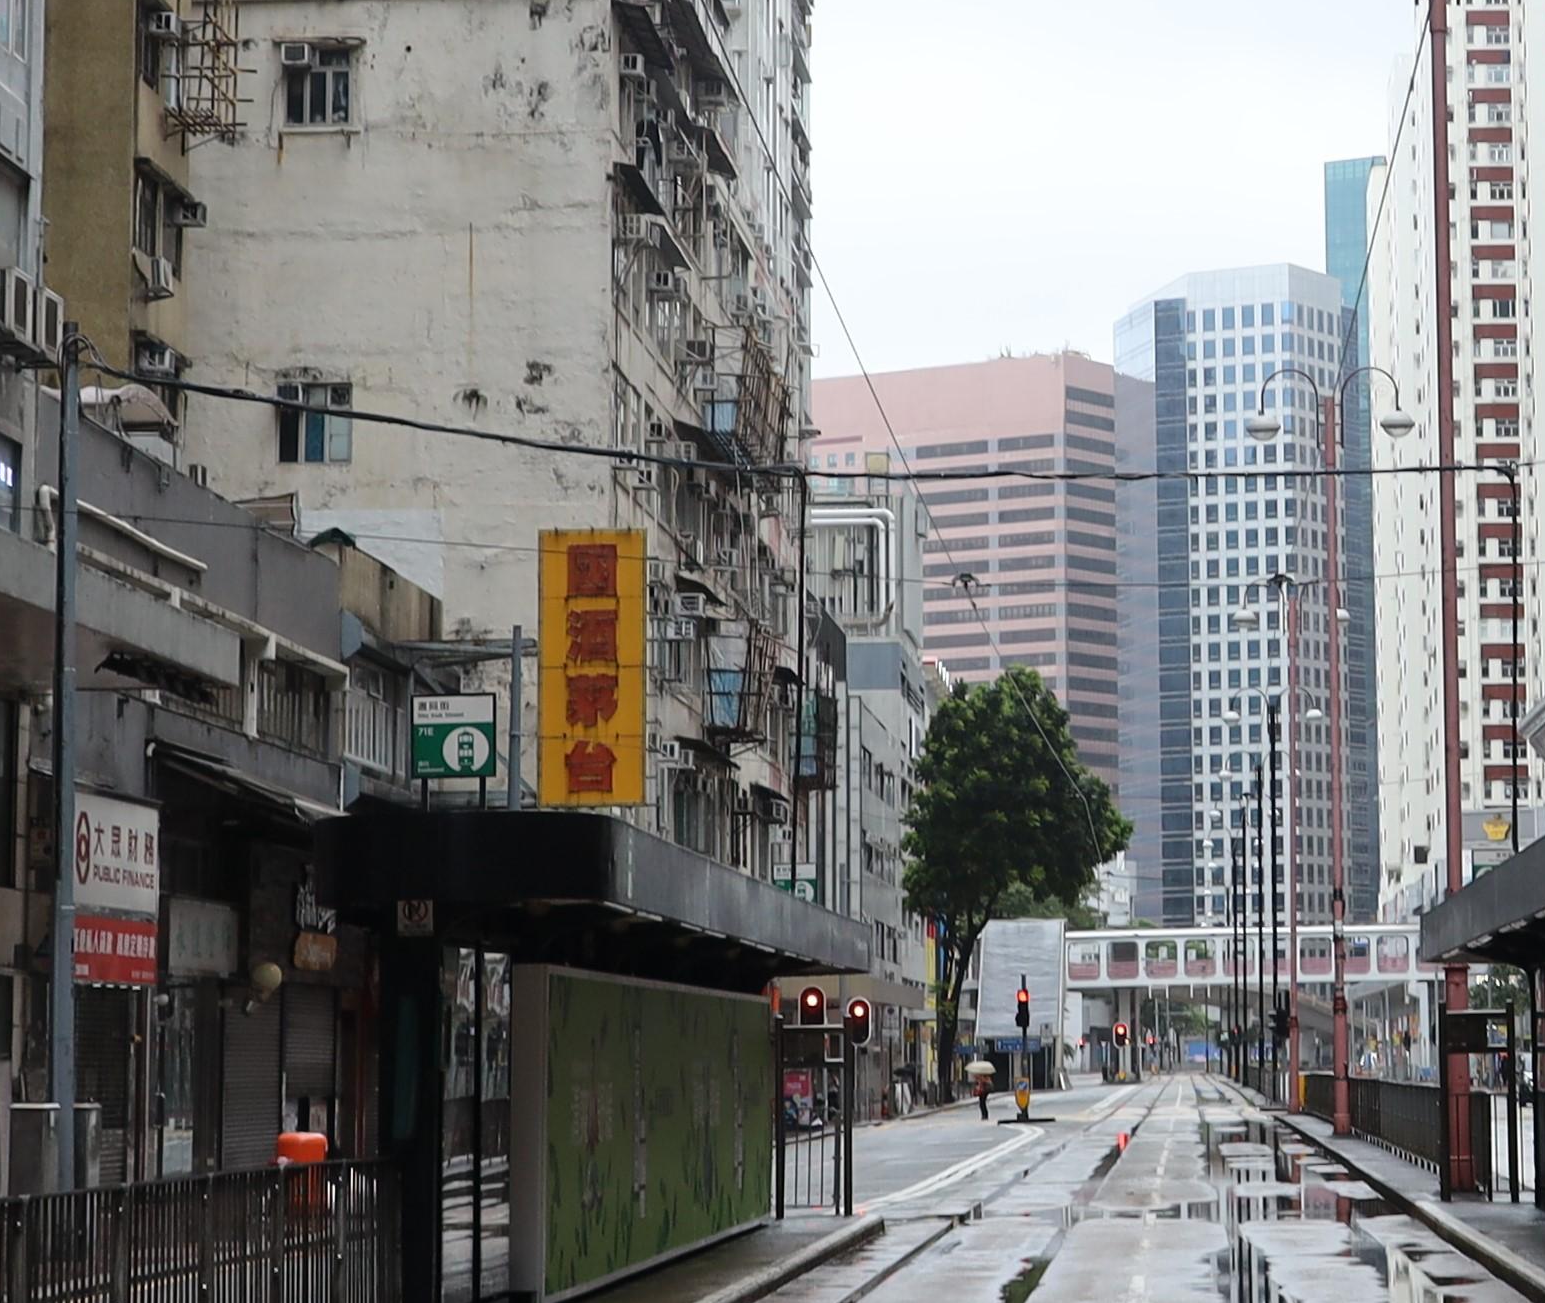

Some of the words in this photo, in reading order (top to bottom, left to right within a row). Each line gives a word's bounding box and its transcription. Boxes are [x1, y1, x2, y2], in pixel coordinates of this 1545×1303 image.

[418, 726, 434, 736] 71E
[92, 821, 155, 866] 大眾財務
[93, 863, 121, 885] PUBLIC
[122, 868, 155, 889] FINANCE
